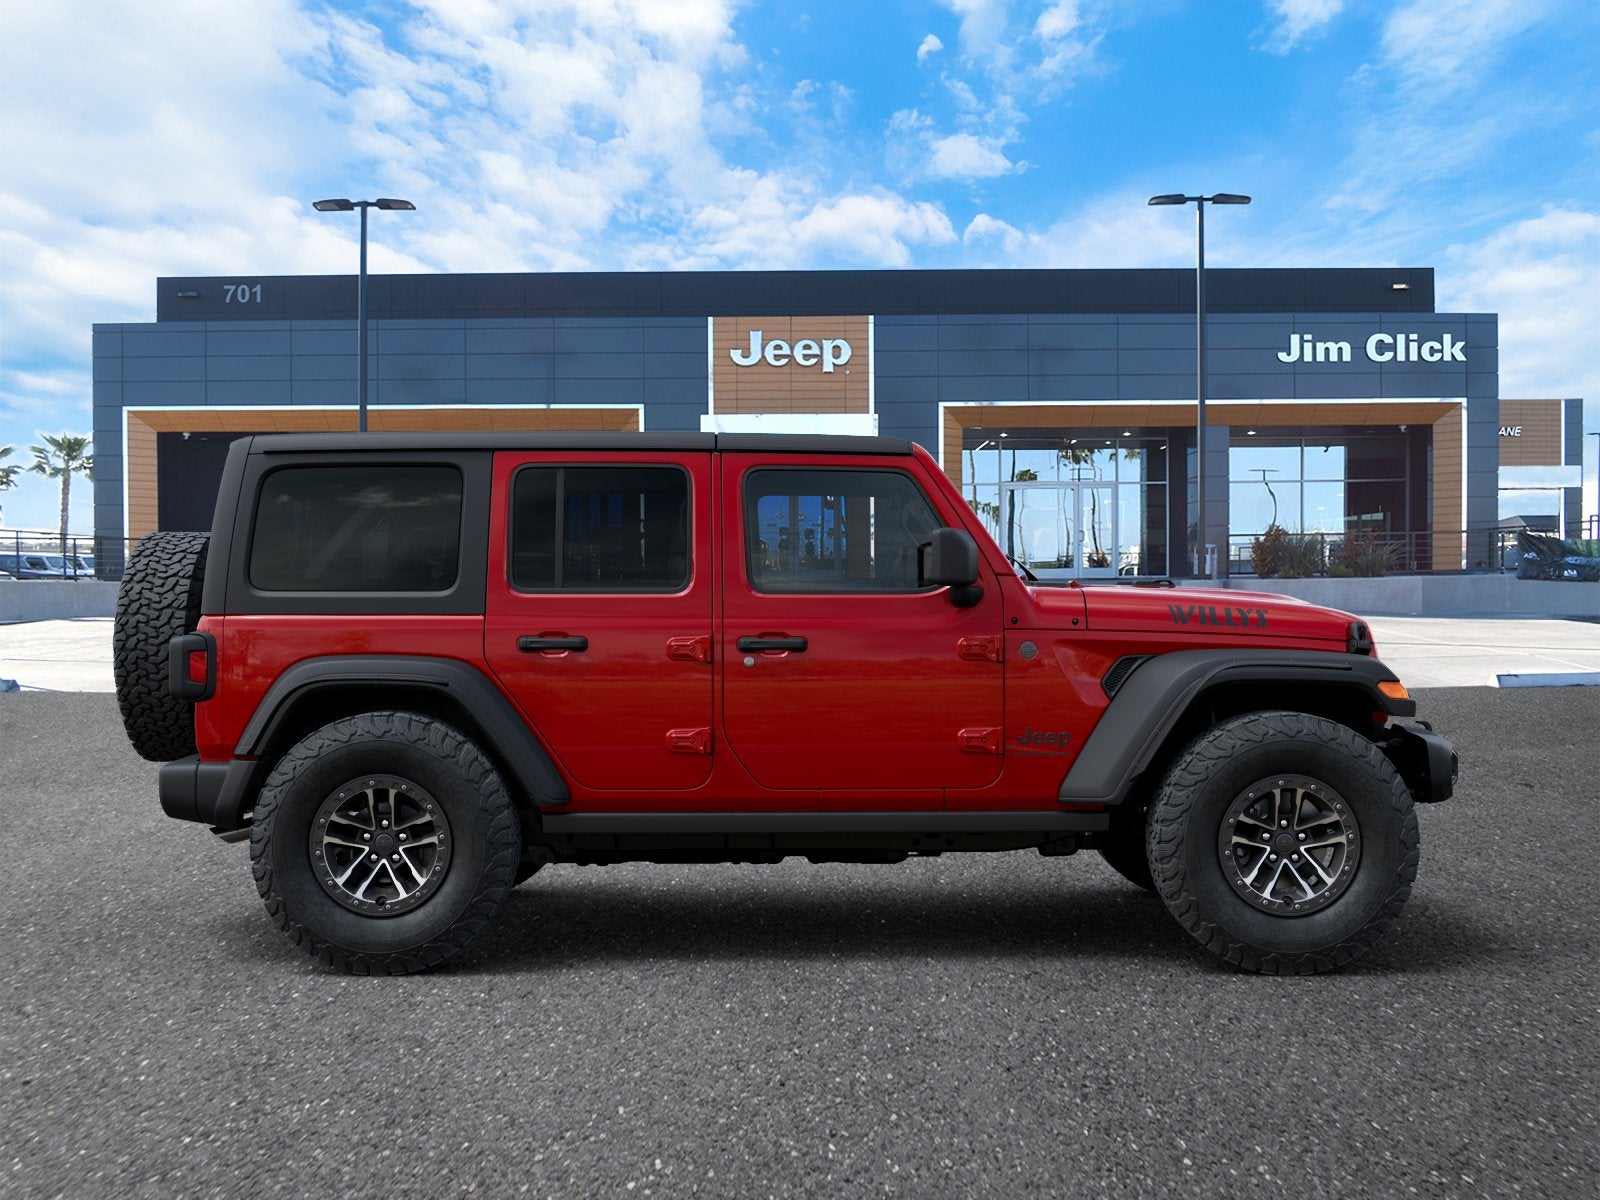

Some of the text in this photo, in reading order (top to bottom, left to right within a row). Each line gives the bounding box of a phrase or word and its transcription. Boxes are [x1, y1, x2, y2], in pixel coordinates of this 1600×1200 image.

[223, 284, 262, 304] 701
[729, 329, 852, 373] Jeep
[1277, 333, 1467, 362] Jim Click
[1167, 604, 1269, 628] WILLYS
[1017, 727, 1071, 749] Jeep
